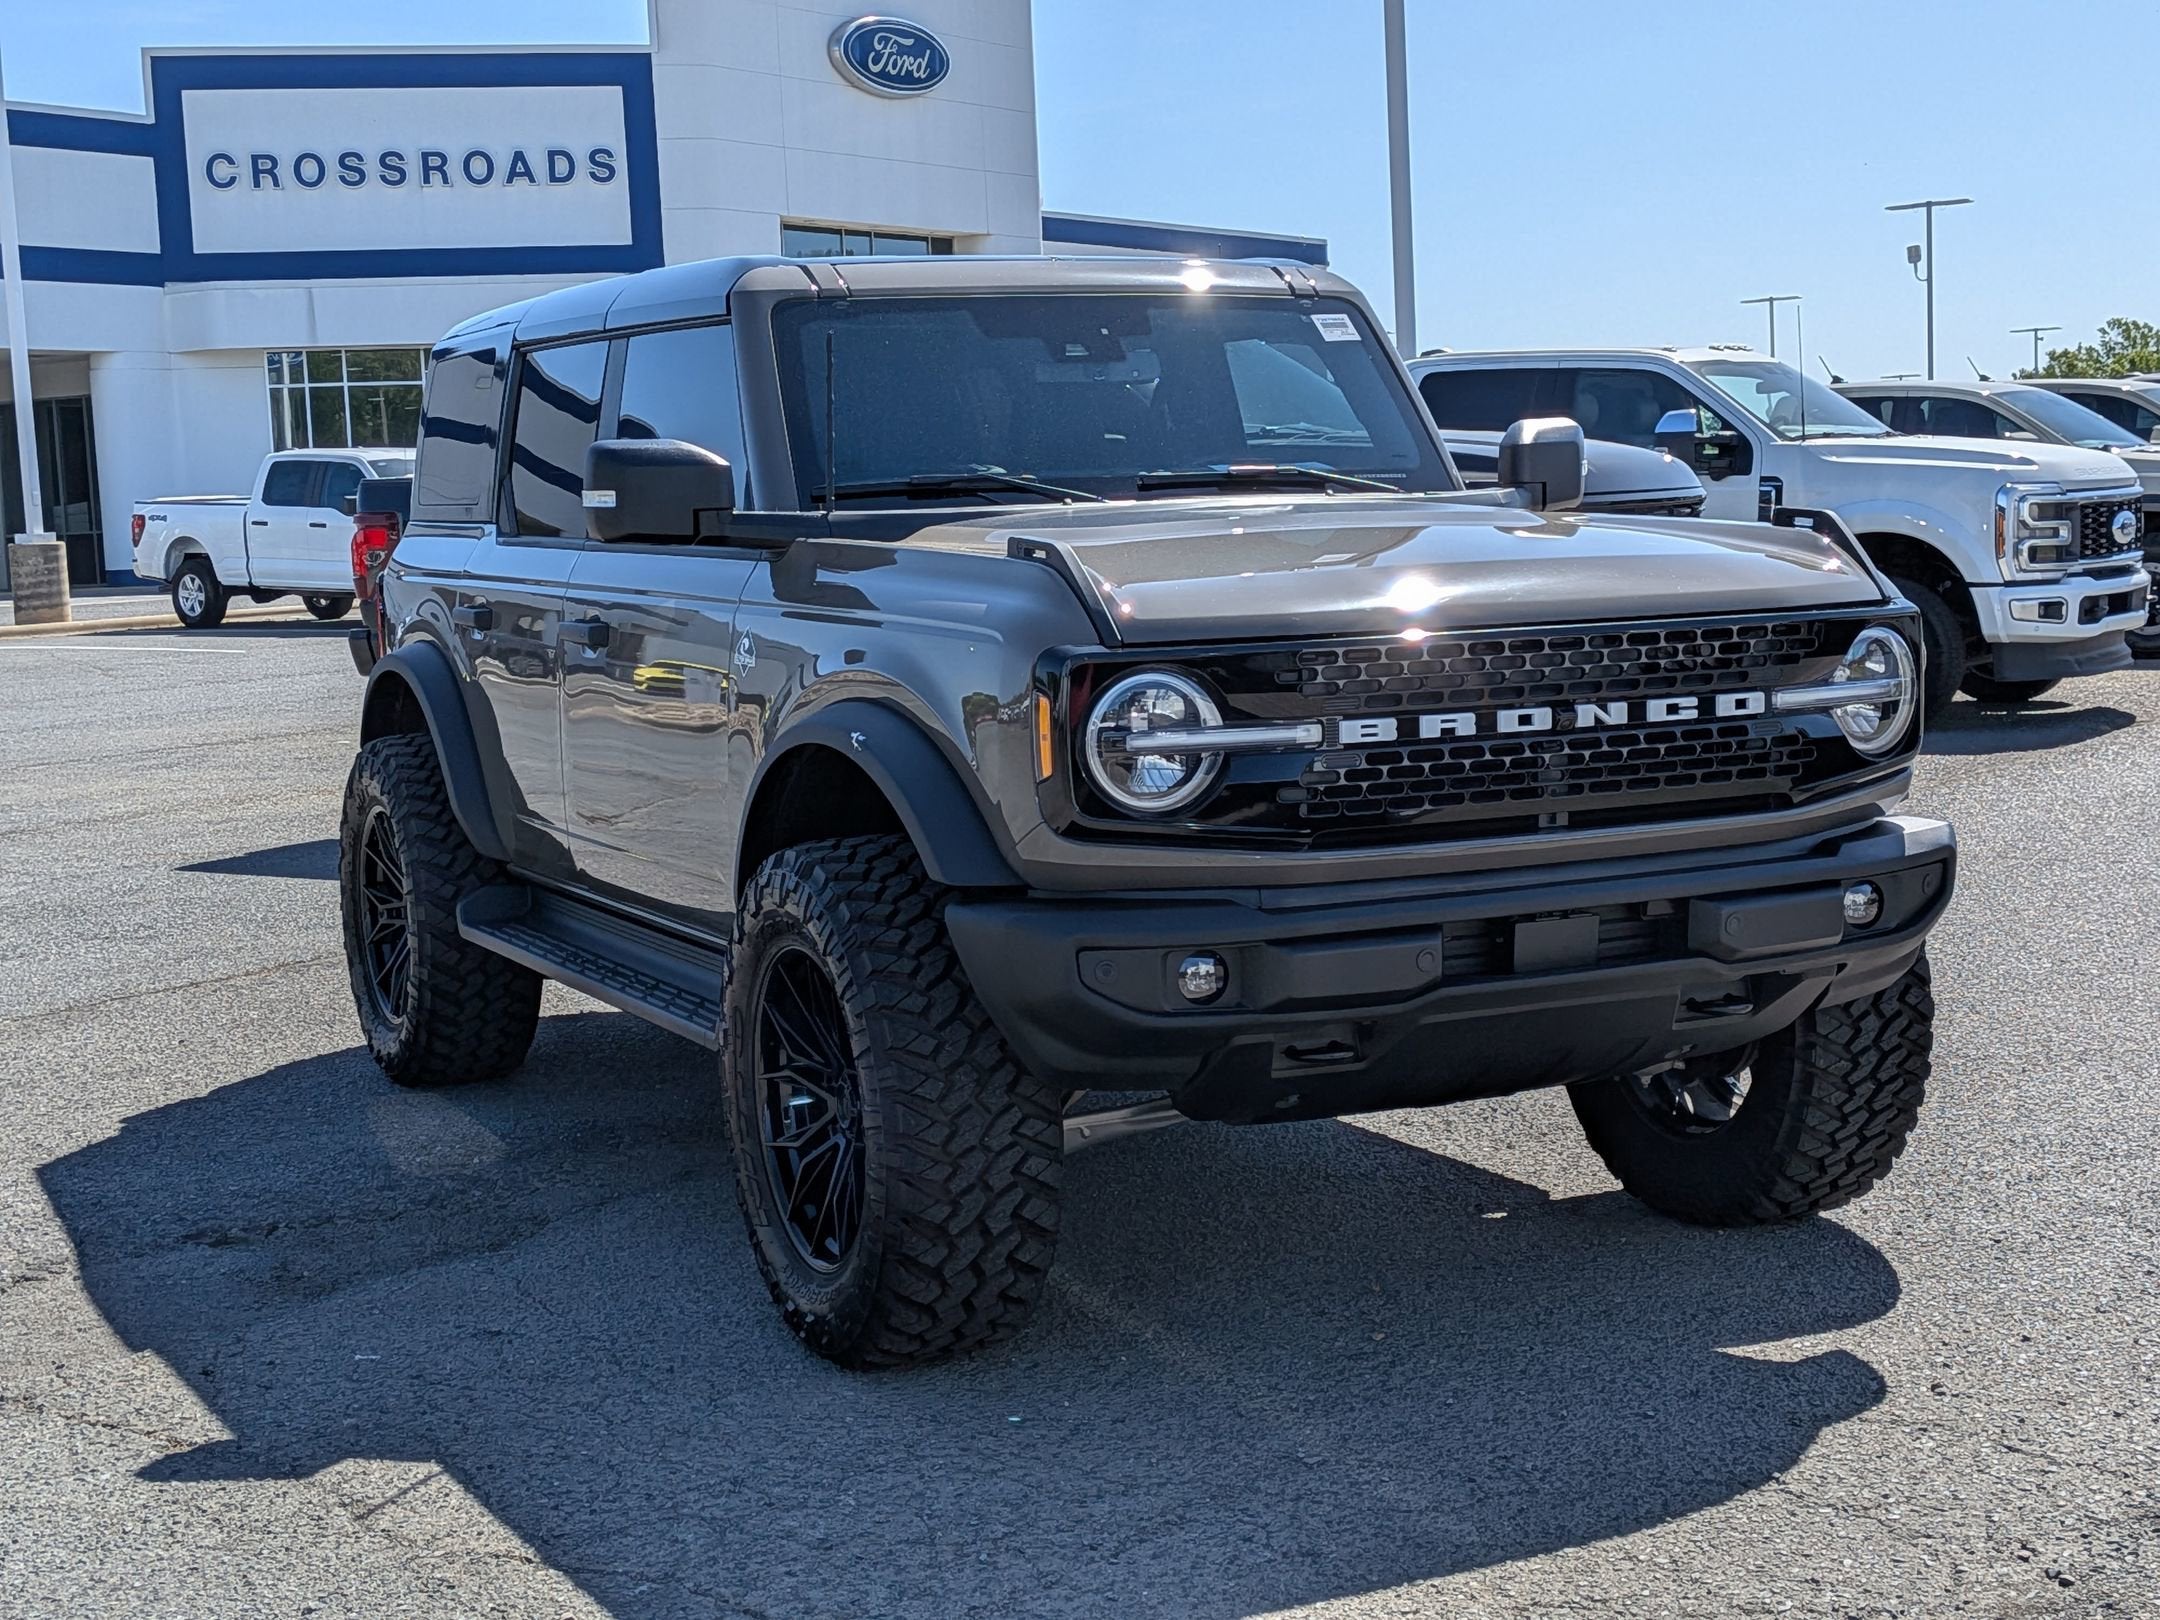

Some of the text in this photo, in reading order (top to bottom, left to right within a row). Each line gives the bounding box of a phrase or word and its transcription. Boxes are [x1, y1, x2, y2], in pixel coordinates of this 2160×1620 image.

[867, 32, 931, 79] Ford
[204, 147, 618, 190] CROSSROADS
[1338, 690, 1767, 745] BRONCO
